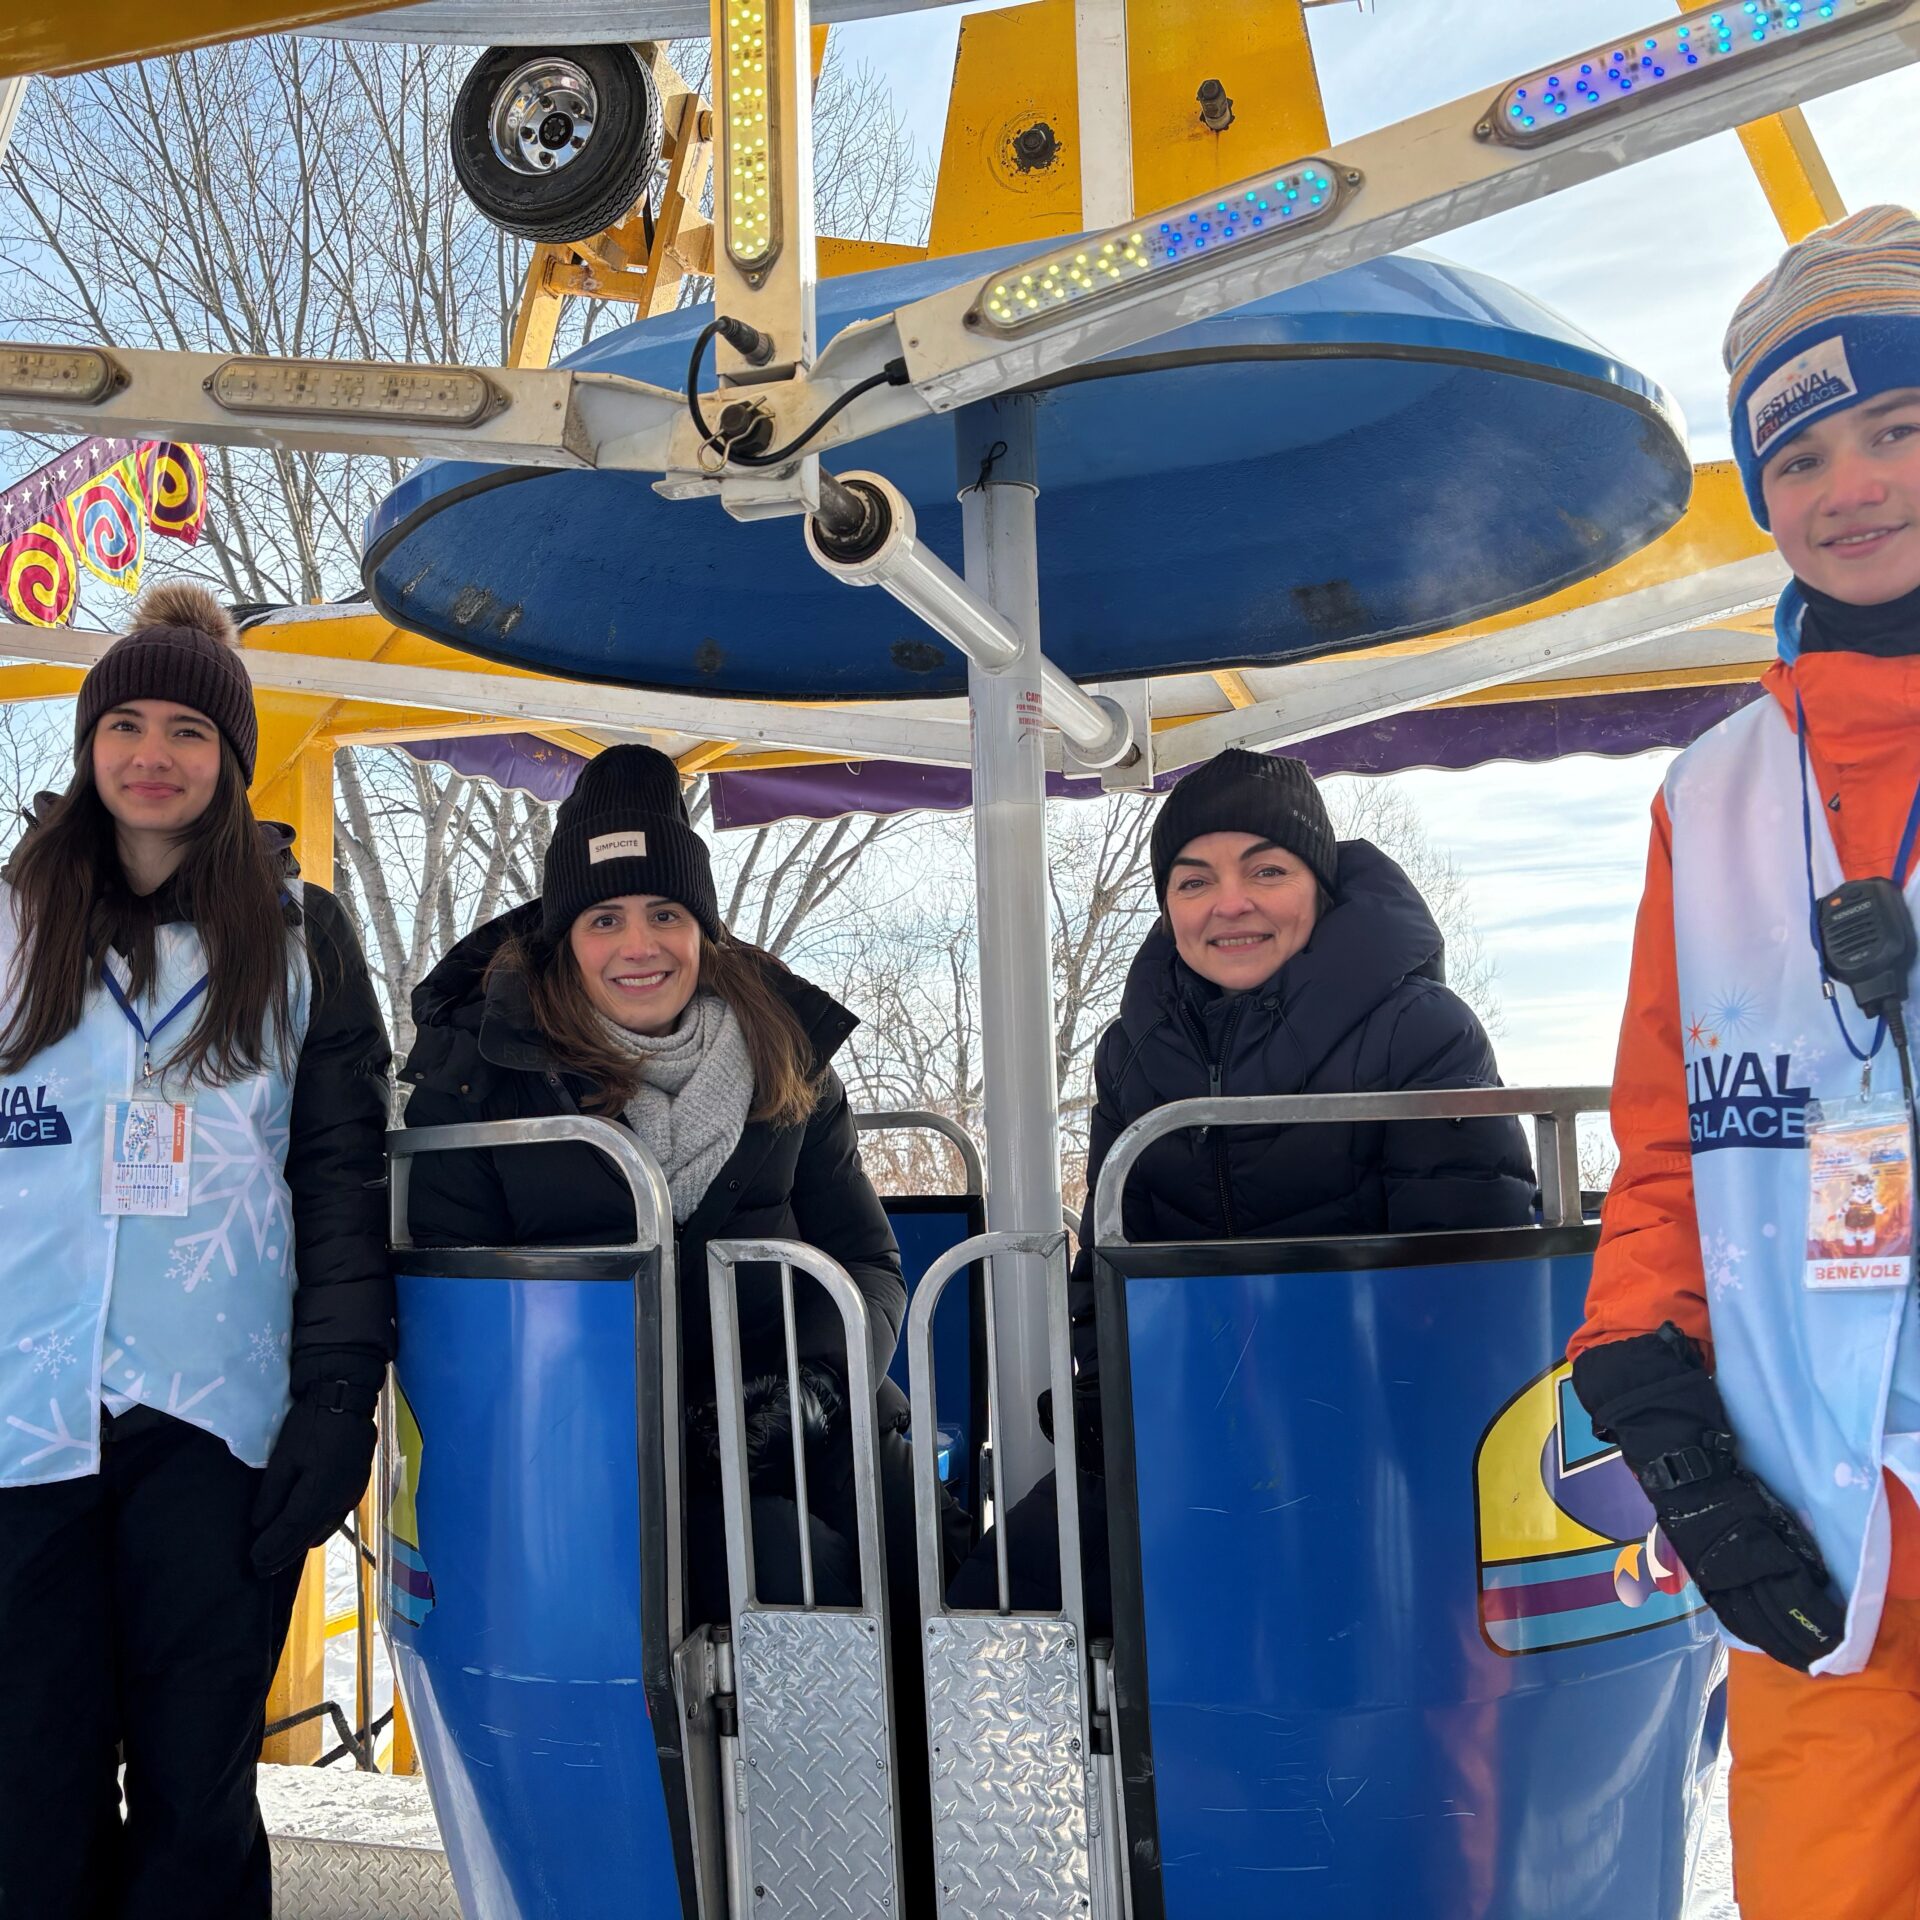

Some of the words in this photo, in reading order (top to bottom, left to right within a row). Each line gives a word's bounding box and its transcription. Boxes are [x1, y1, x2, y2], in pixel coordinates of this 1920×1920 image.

[1756, 369, 1838, 427] FESTIVAL
[1790, 381, 1841, 415] GLACE
[1685, 1052, 1811, 1102] IVAL
[0, 1118, 58, 1142] ACE
[1689, 1105, 1805, 1143] GLACE
